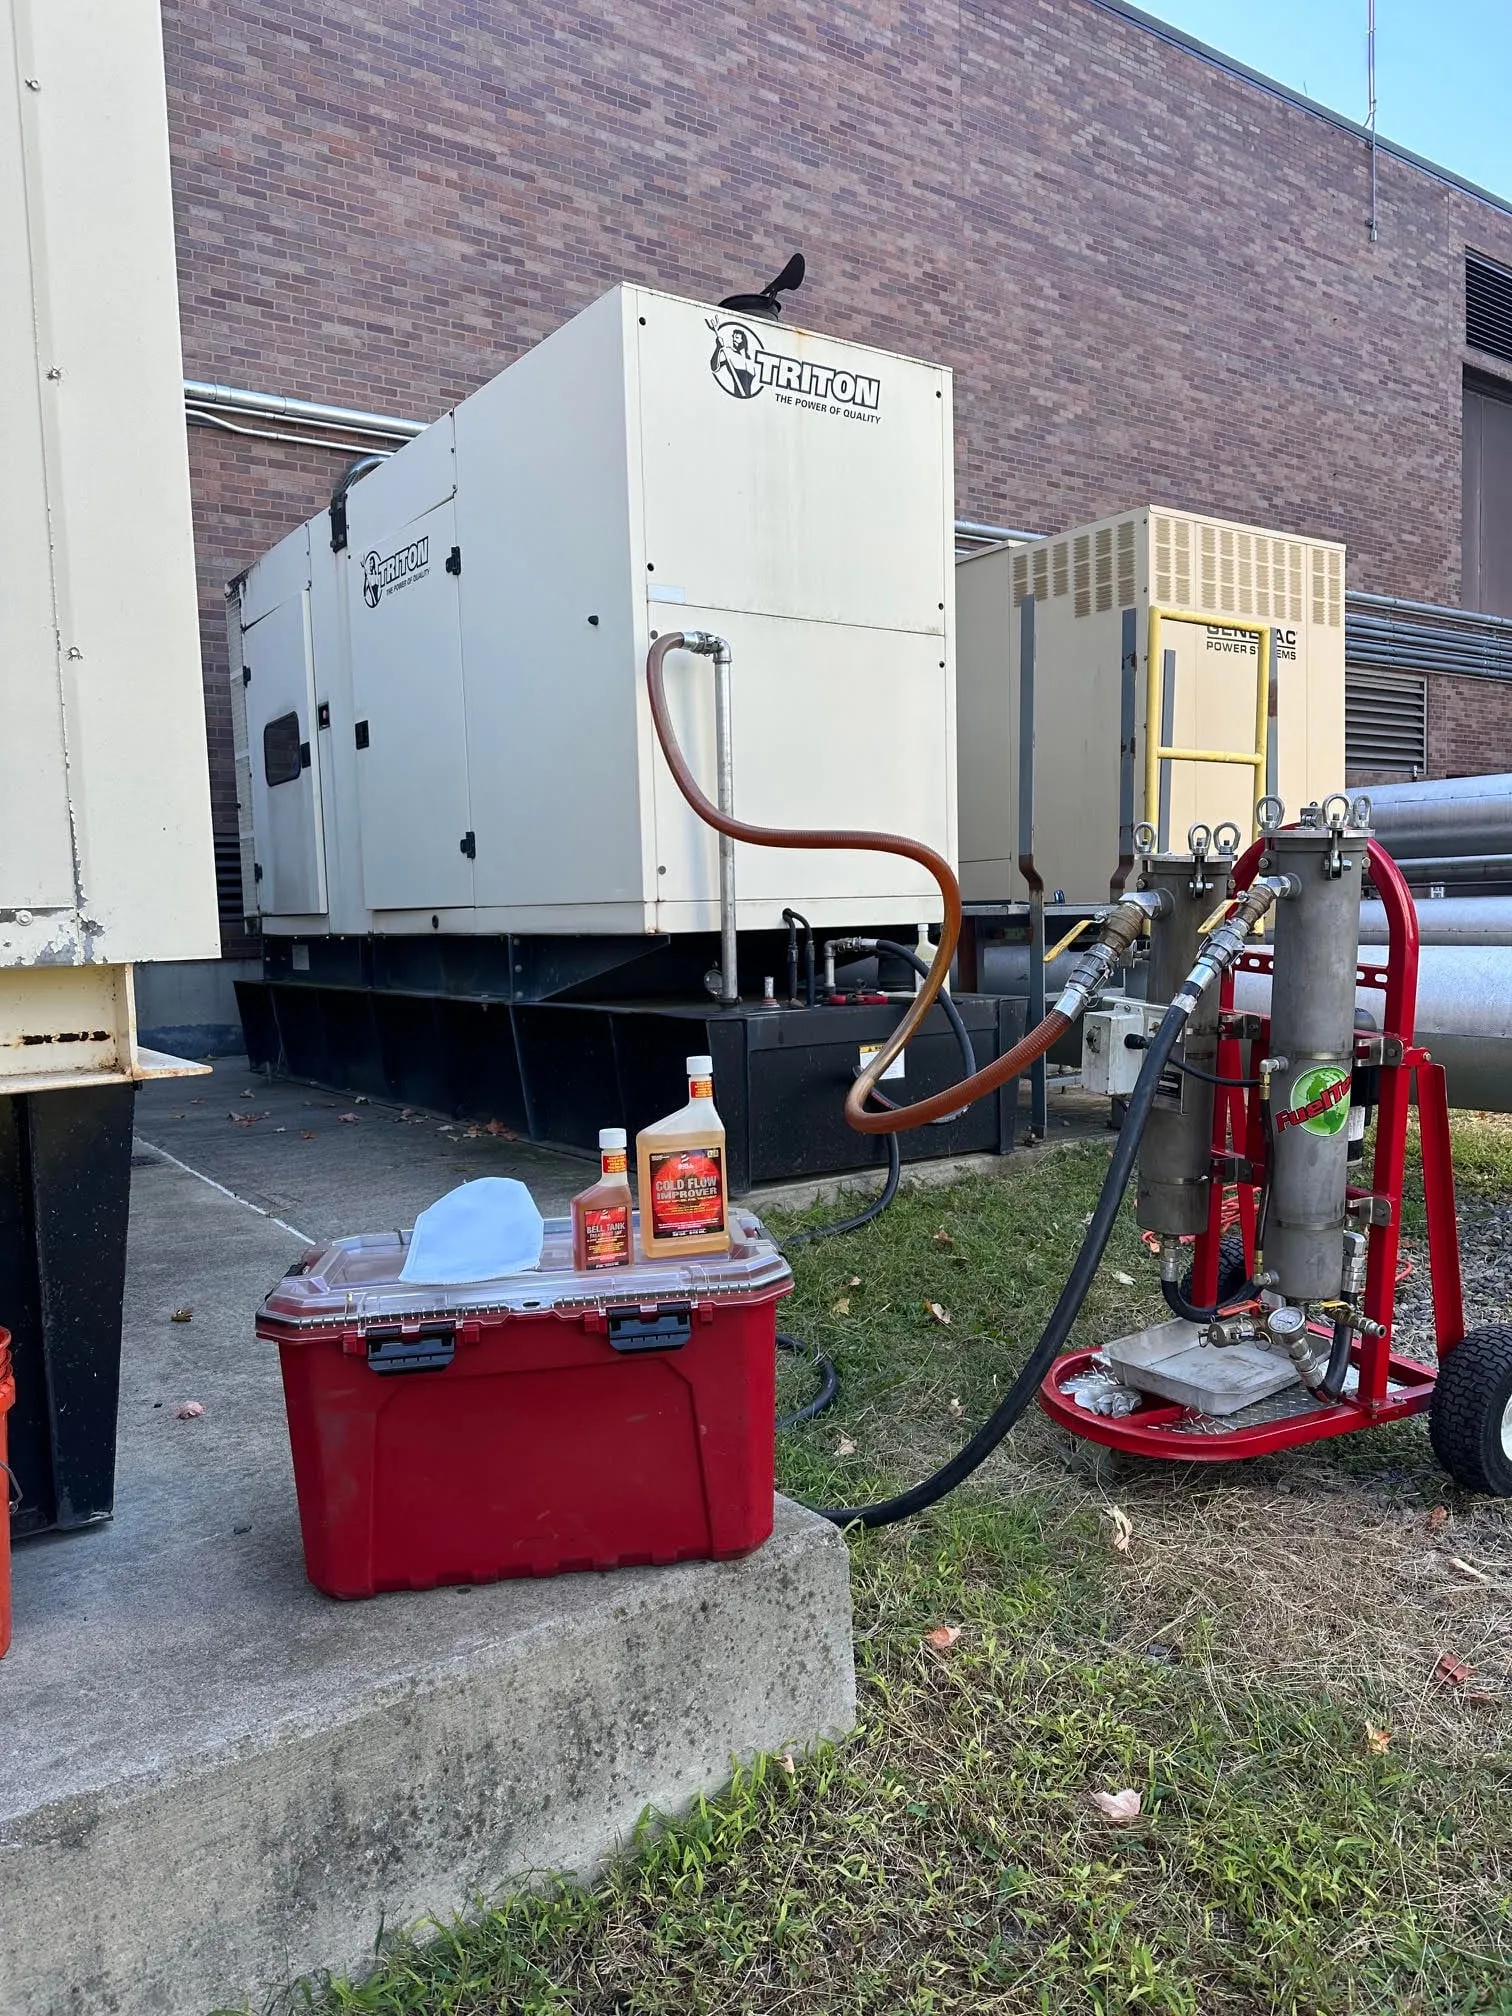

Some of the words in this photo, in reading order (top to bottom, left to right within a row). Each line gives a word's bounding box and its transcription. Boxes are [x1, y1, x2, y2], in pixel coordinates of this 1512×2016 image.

[755, 350, 881, 410] TRITON
[775, 393, 792, 405] THE
[794, 397, 827, 413] POWER
[829, 405, 842, 416] OF
[843, 409, 882, 424] QUALITY
[378, 535, 429, 588] TRITON
[394, 579, 406, 591] POWER
[1206, 625, 1296, 645] GENEAC
[1206, 640, 1247, 654] POWER
[1249, 645, 1297, 661] SEMS
[656, 1178, 685, 1192] COLD
[687, 1175, 717, 1189] FLOW
[656, 1186, 718, 1201] IMPROVER
[586, 1224, 603, 1234] BELL
[606, 1221, 626, 1232] TANK
